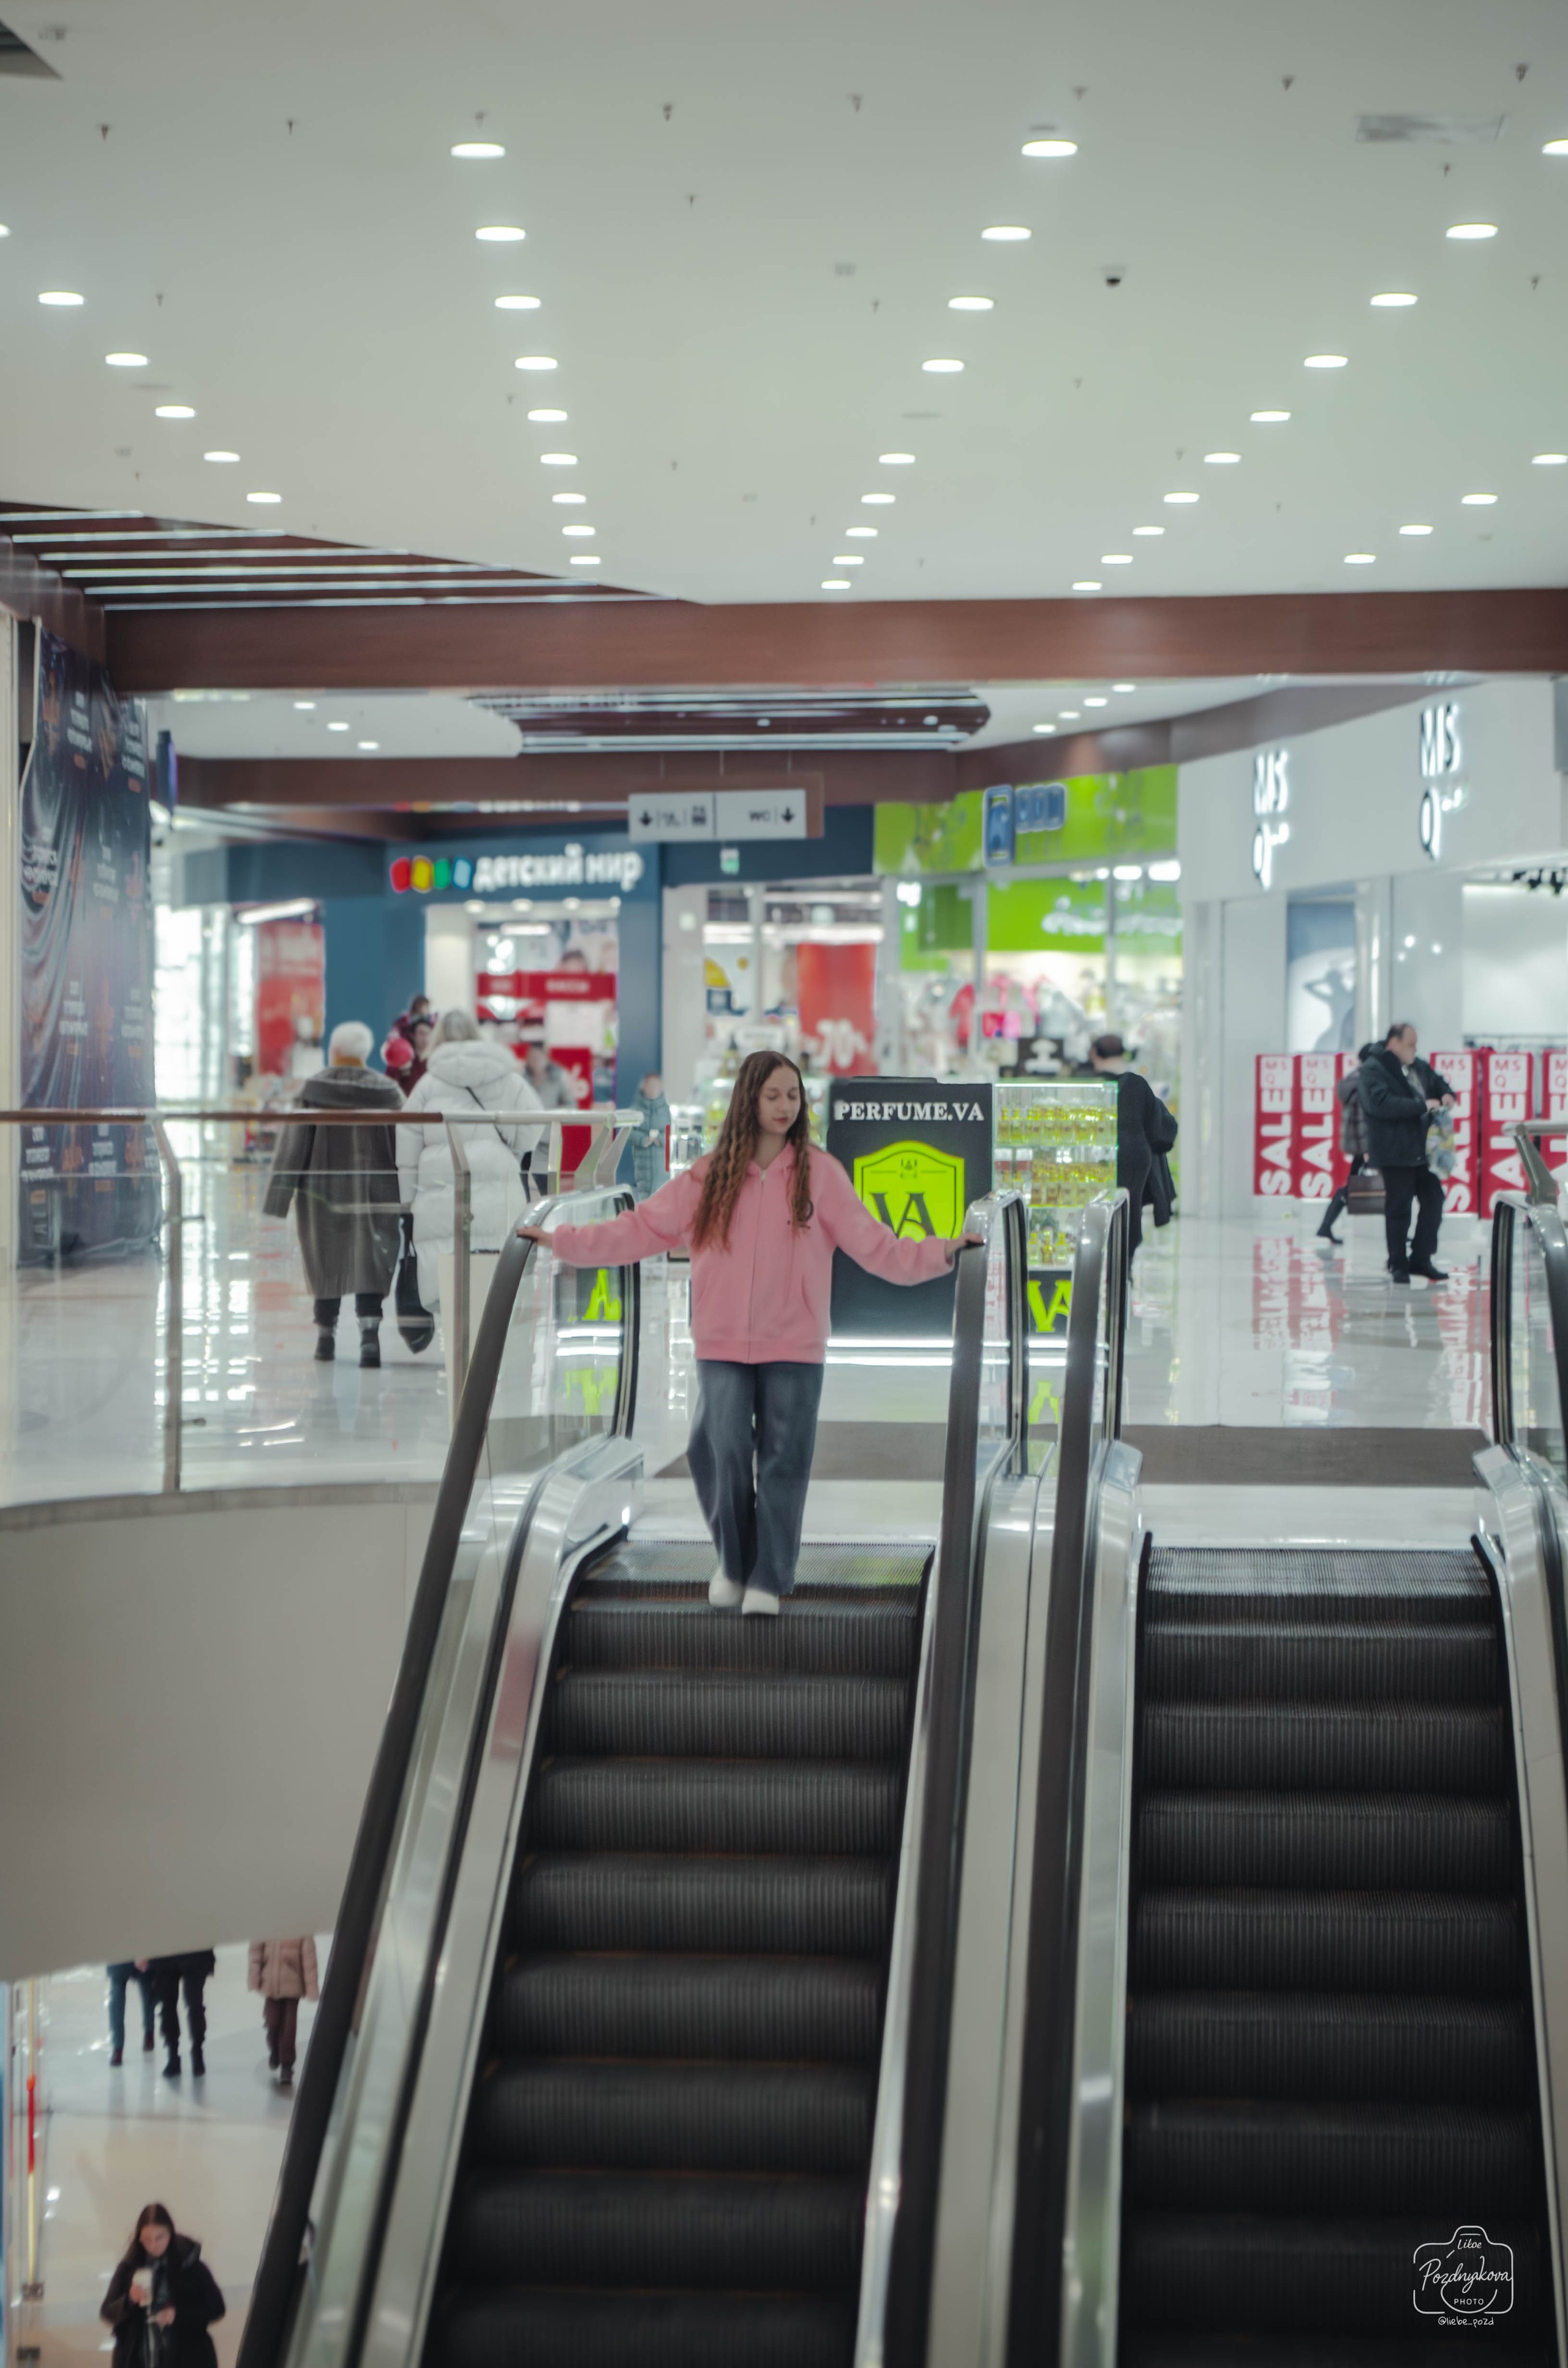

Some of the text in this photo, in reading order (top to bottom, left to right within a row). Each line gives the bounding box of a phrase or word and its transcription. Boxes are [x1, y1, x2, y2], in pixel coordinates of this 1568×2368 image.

[749, 809, 771, 822] WC
[834, 1100, 984, 1121] PERFUME.VA
[1260, 1089, 1292, 1195] SALE
[1300, 1088, 1333, 1198] SALE
